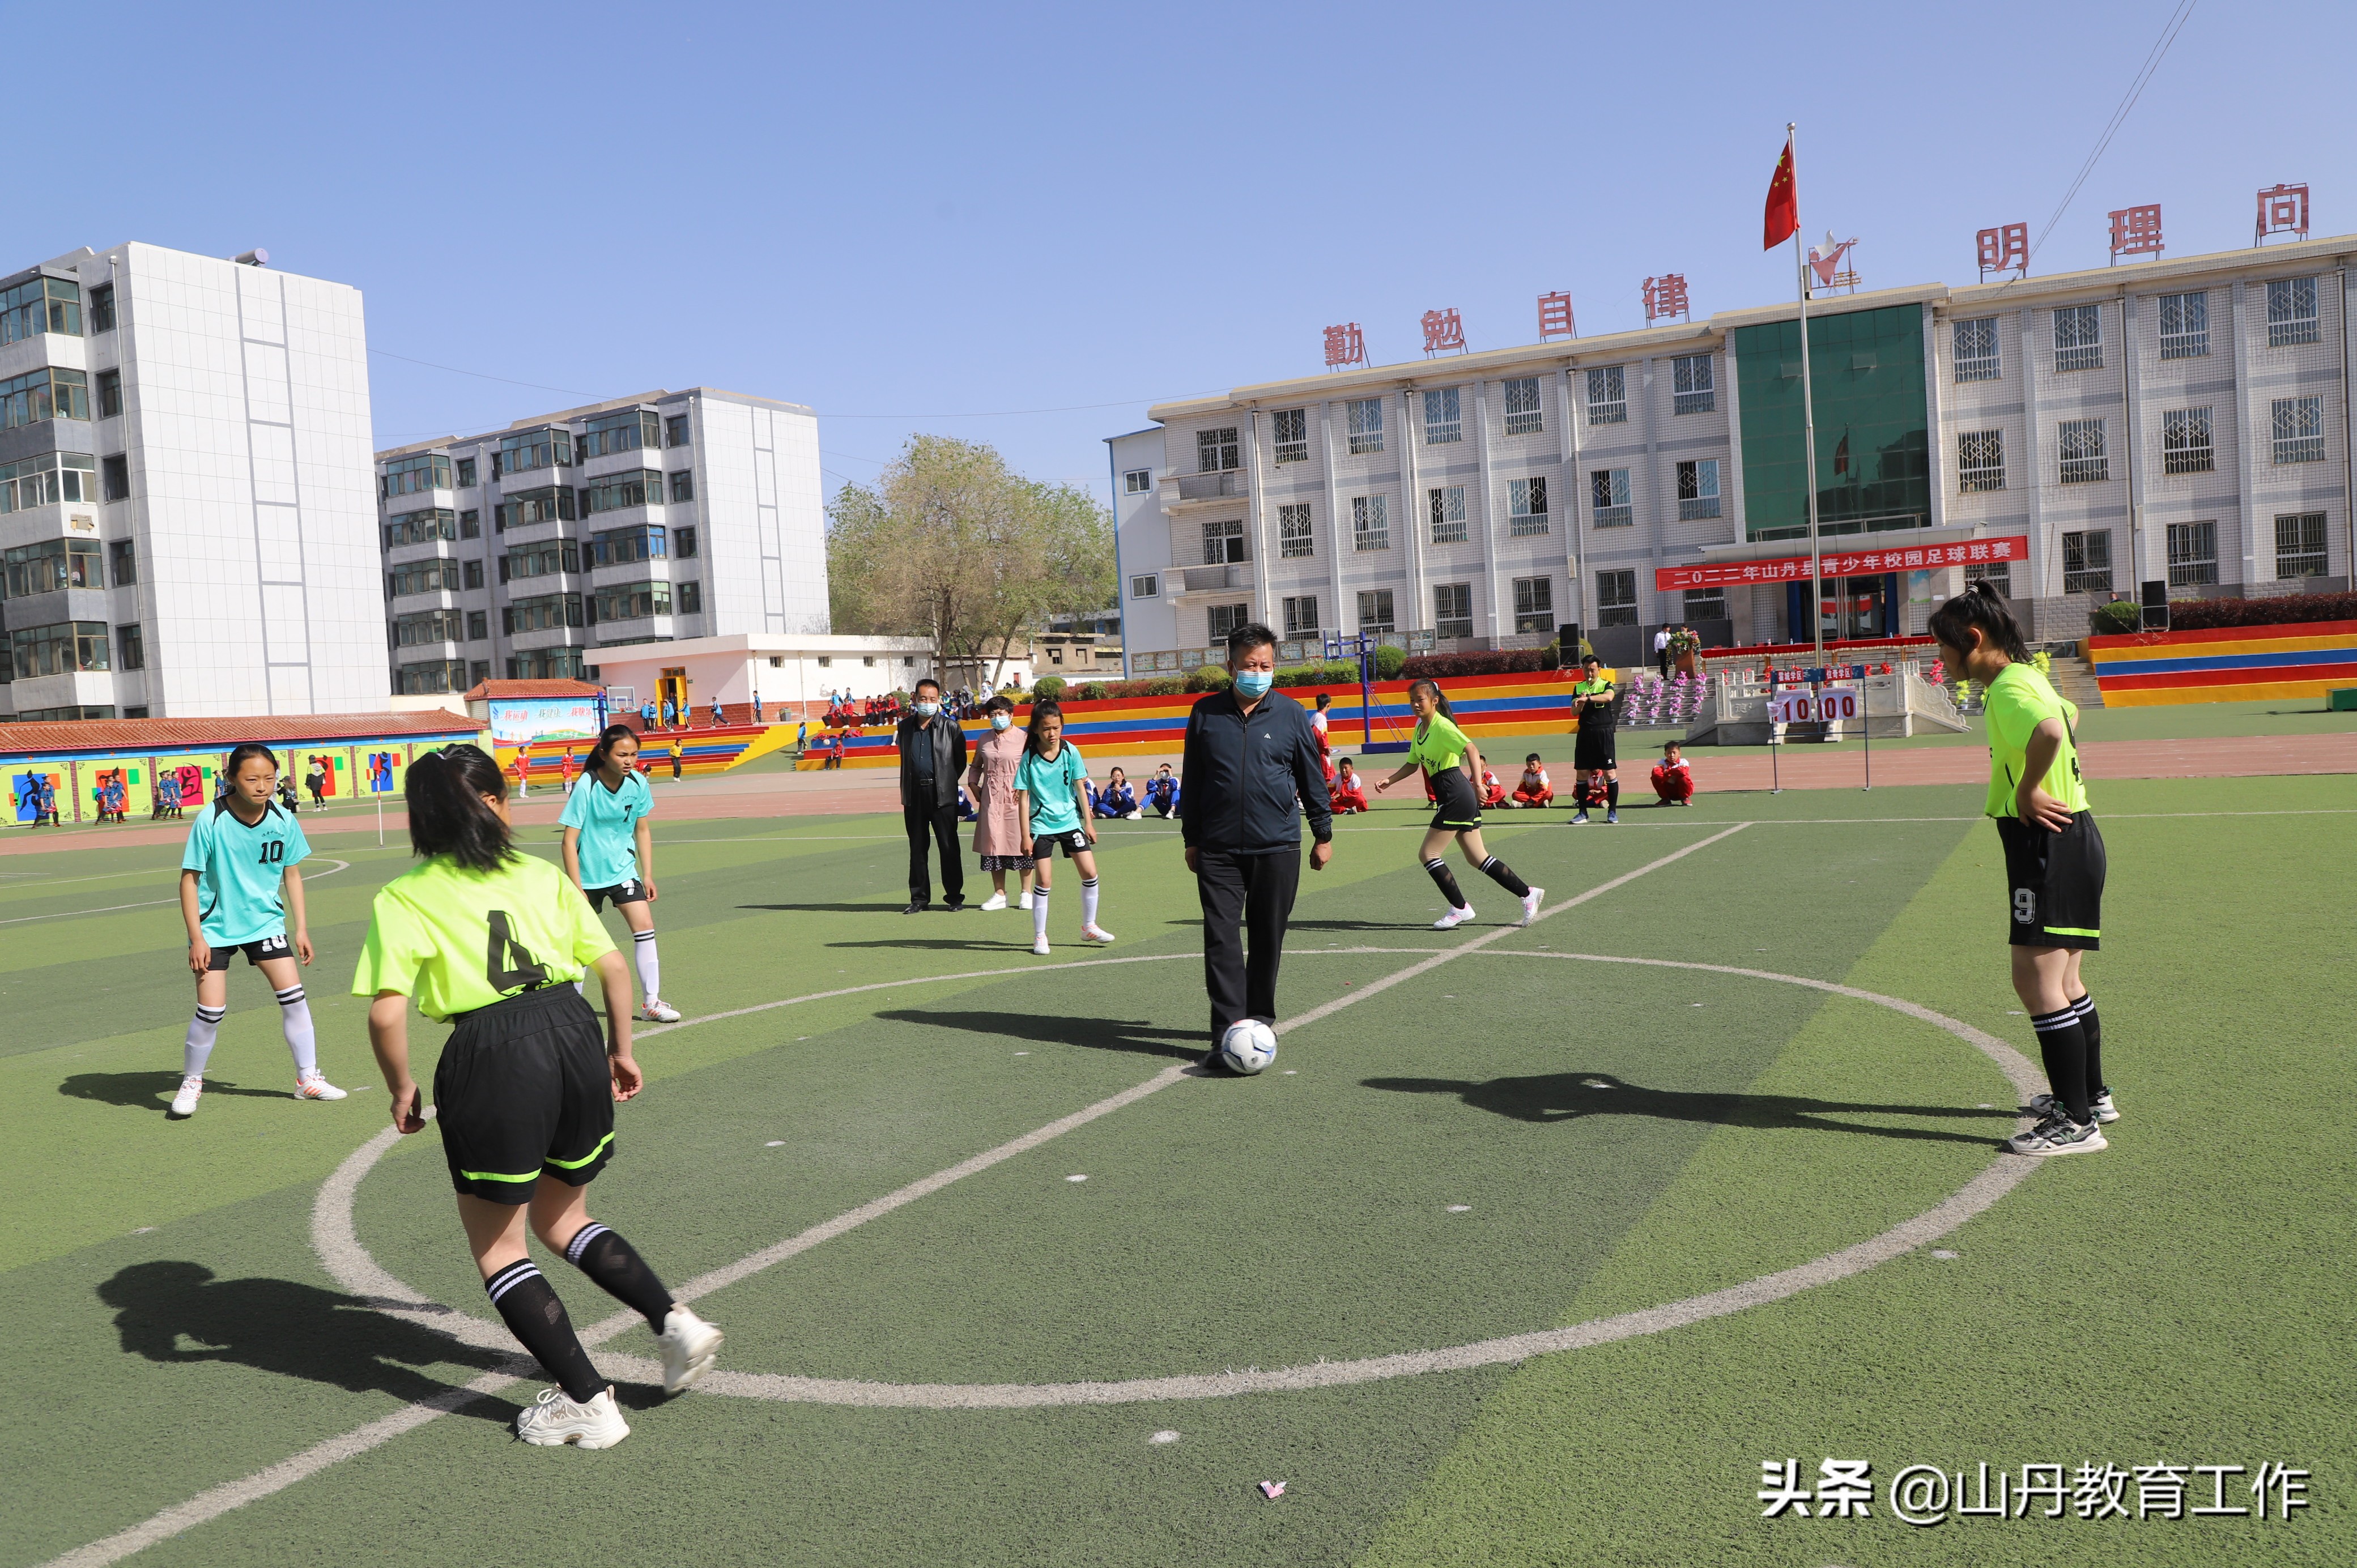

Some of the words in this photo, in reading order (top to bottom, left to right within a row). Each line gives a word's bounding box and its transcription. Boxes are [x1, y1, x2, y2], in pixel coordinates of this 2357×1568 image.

[501, 709, 528, 722] 我运动
[535, 706, 562, 720] 我健康
[623, 804, 633, 823] 7
[258, 841, 284, 864] 10
[2014, 888, 2035, 924] 9
[487, 910, 554, 997] 4
